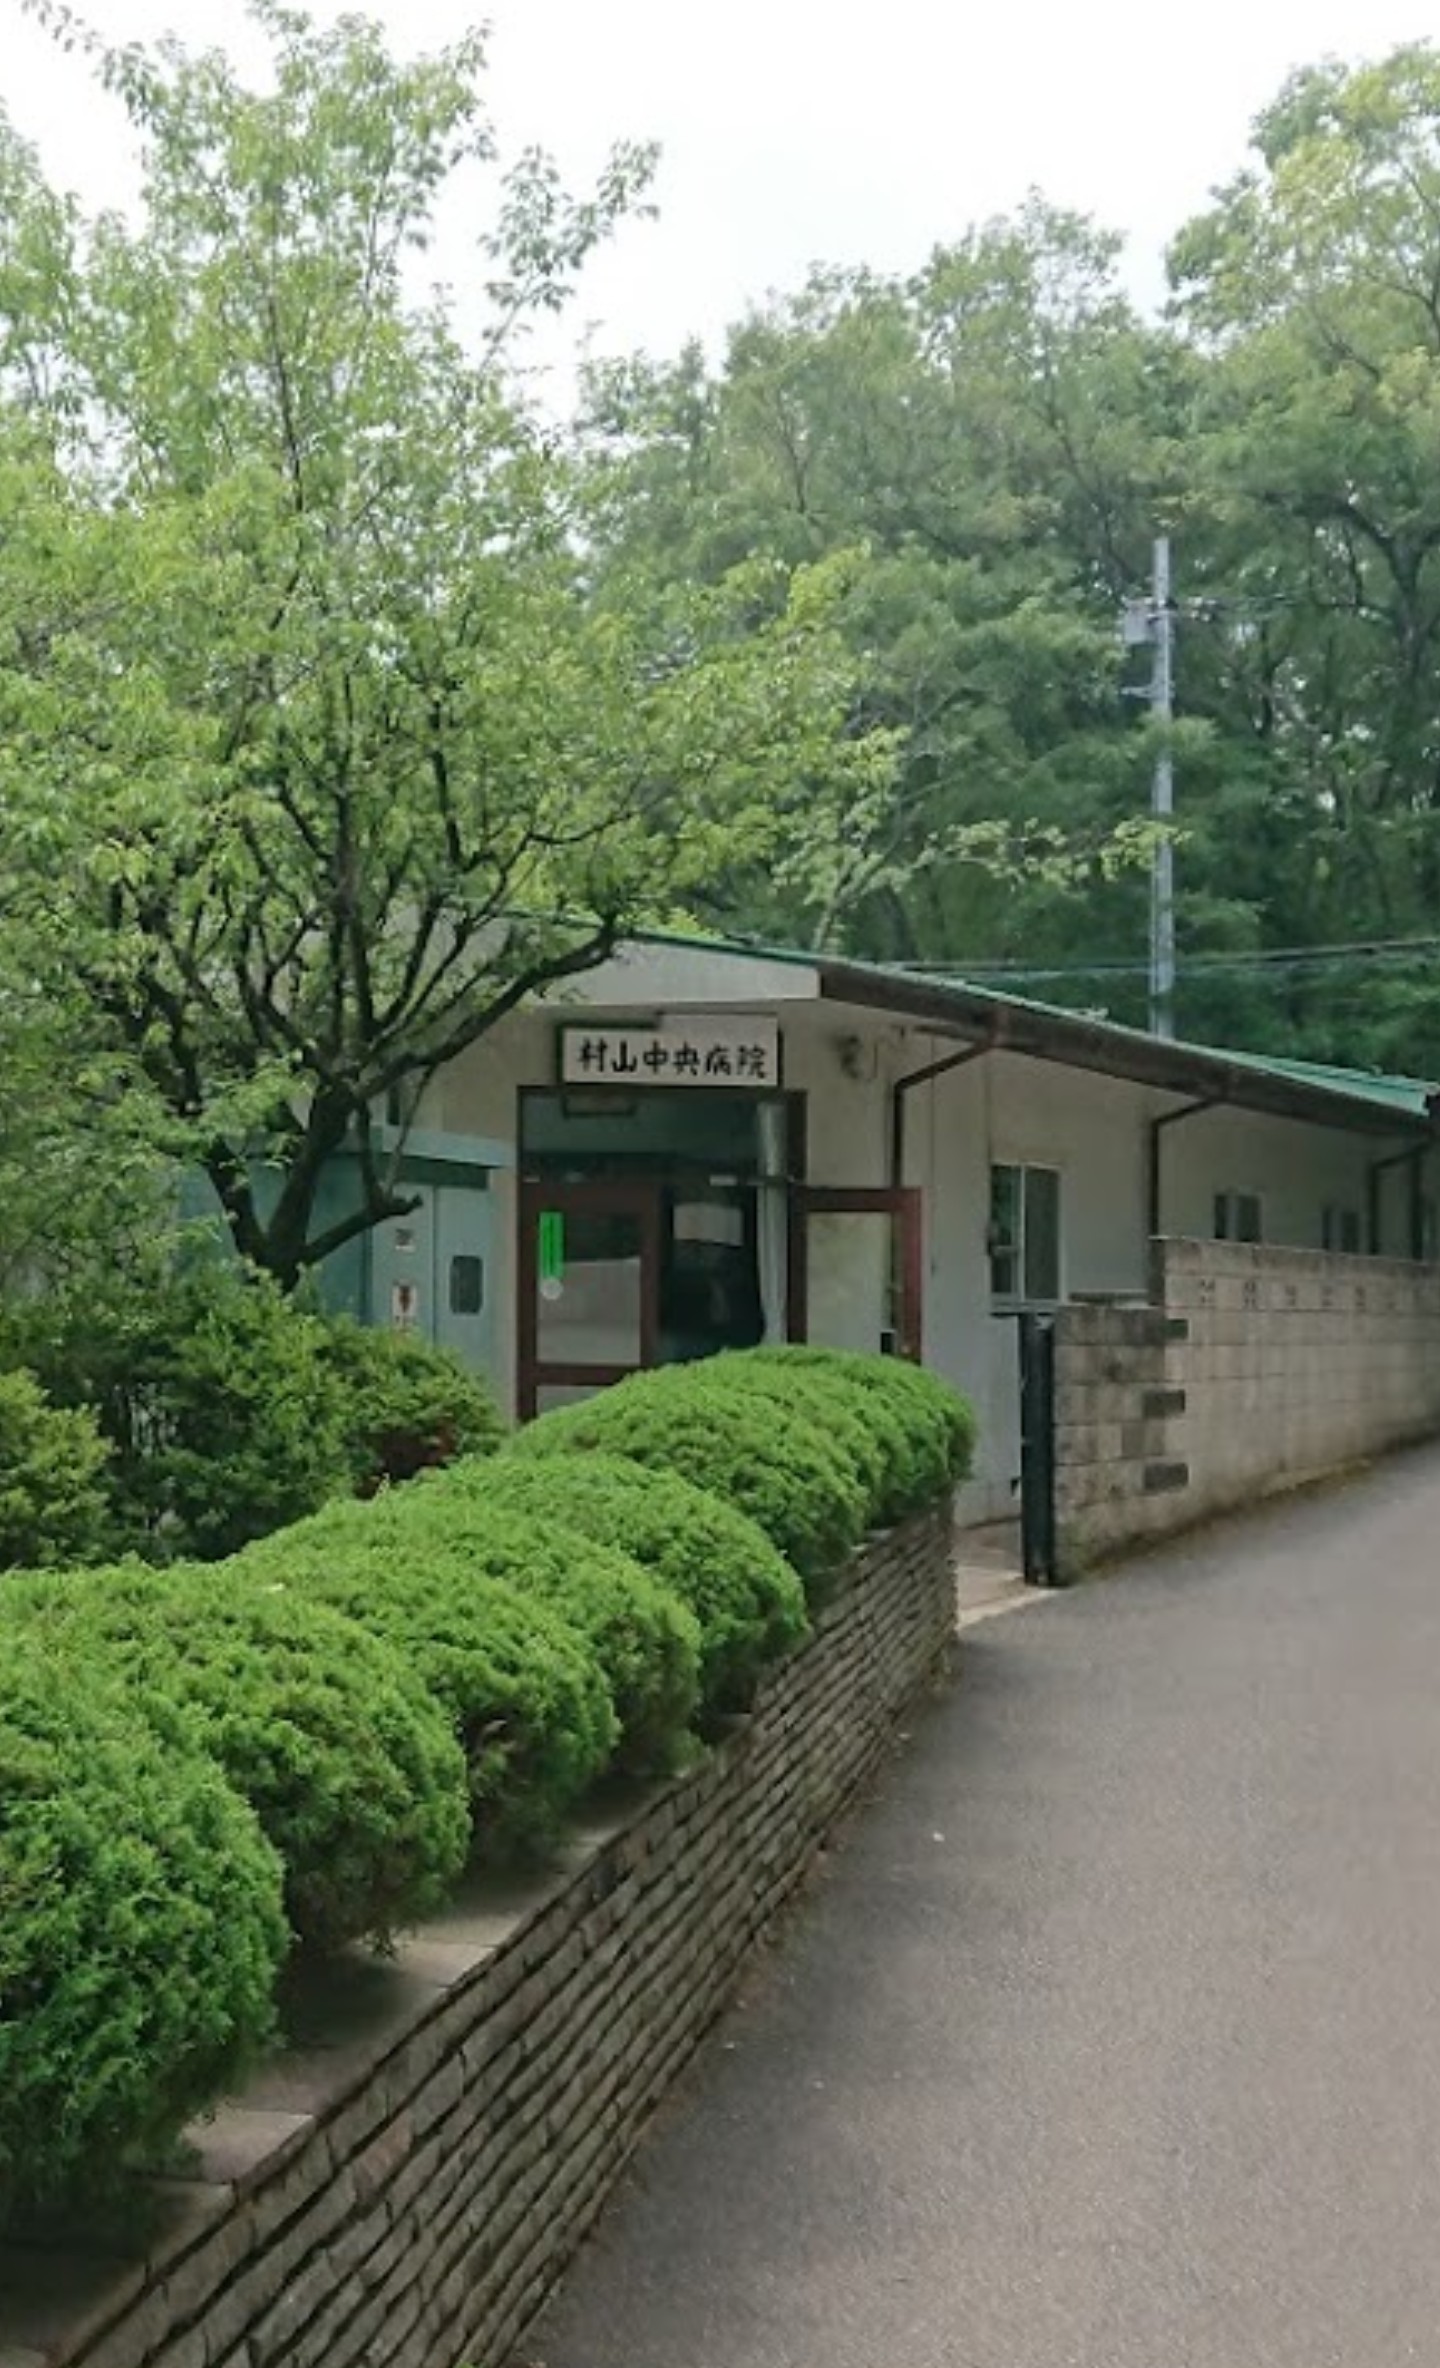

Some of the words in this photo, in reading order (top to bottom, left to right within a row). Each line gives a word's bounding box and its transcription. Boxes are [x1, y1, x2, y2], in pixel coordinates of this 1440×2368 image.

[578, 1038, 767, 1079] 村山中央病院
